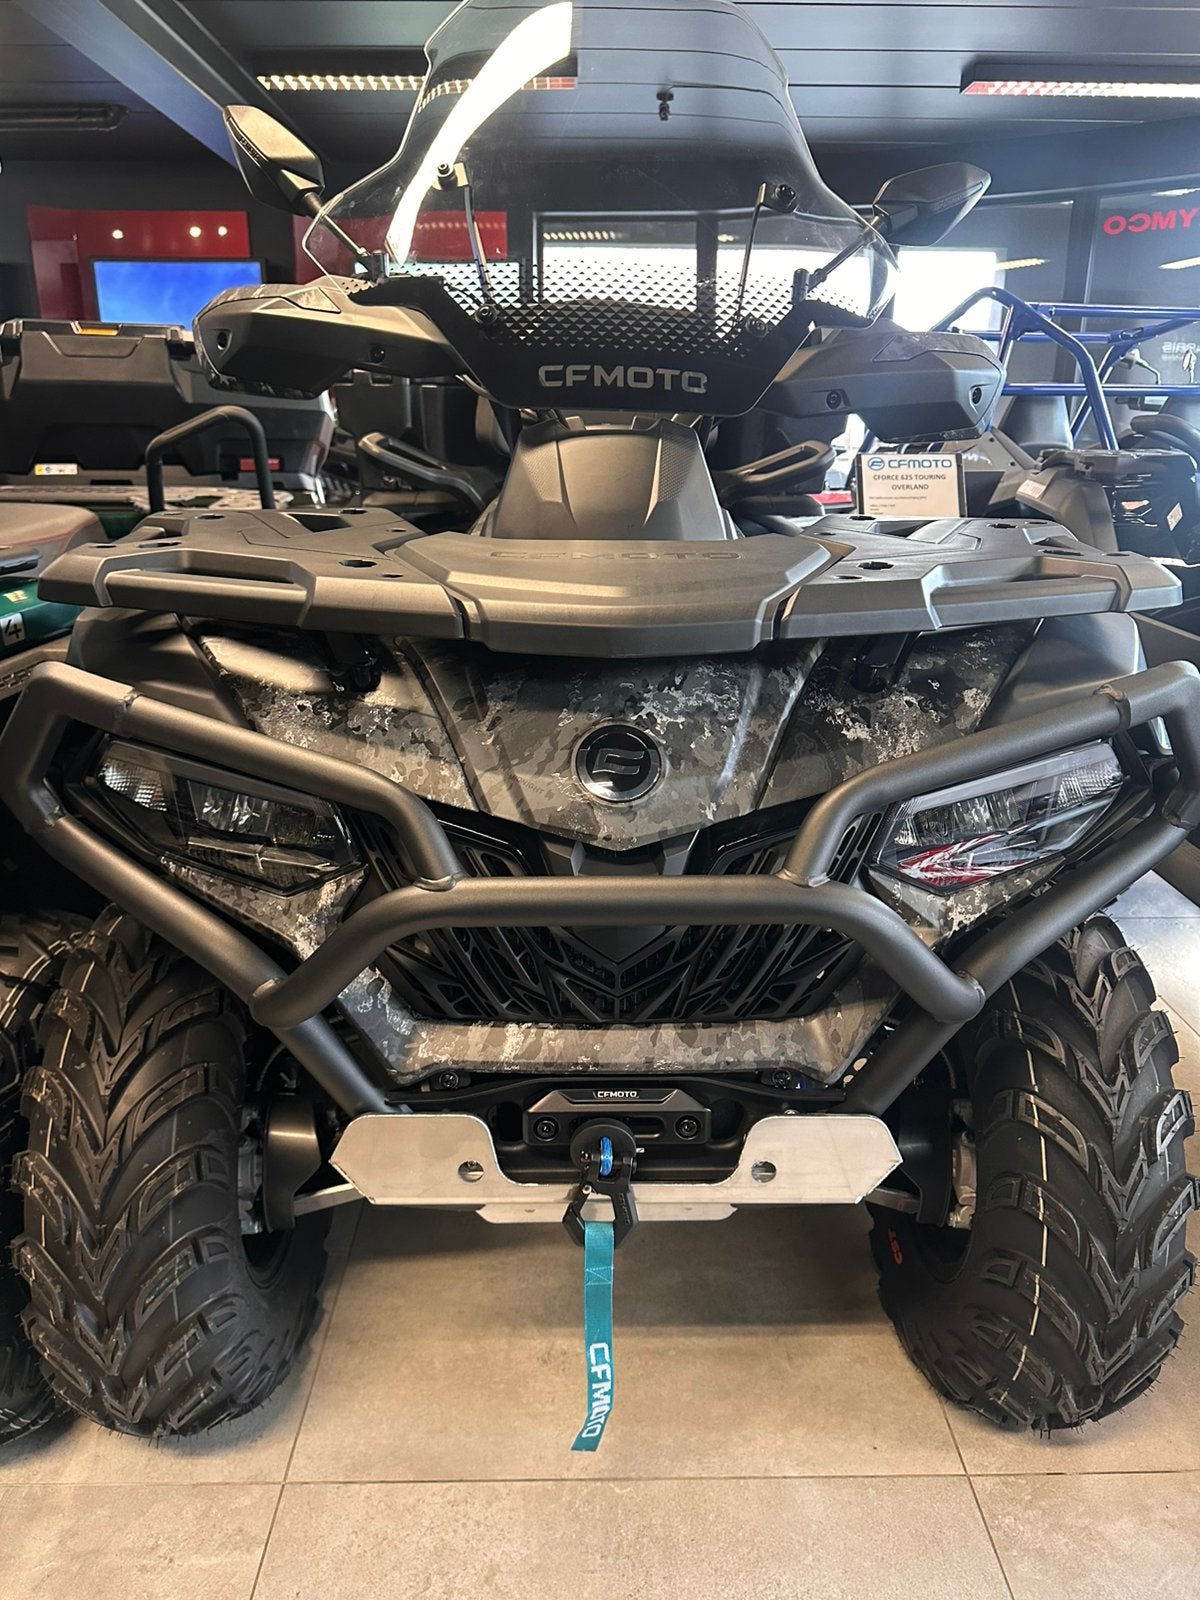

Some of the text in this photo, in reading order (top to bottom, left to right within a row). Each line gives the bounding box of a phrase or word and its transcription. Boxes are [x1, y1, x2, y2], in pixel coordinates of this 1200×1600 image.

[538, 364, 708, 394] CFMOTO
[887, 458, 953, 469] CFMOTO
[915, 473, 947, 481] TOURING
[490, 551, 743, 560] CFMOTO
[597, 1090, 638, 1098] CFMOTO
[581, 1341, 612, 1438] CFMOTO
